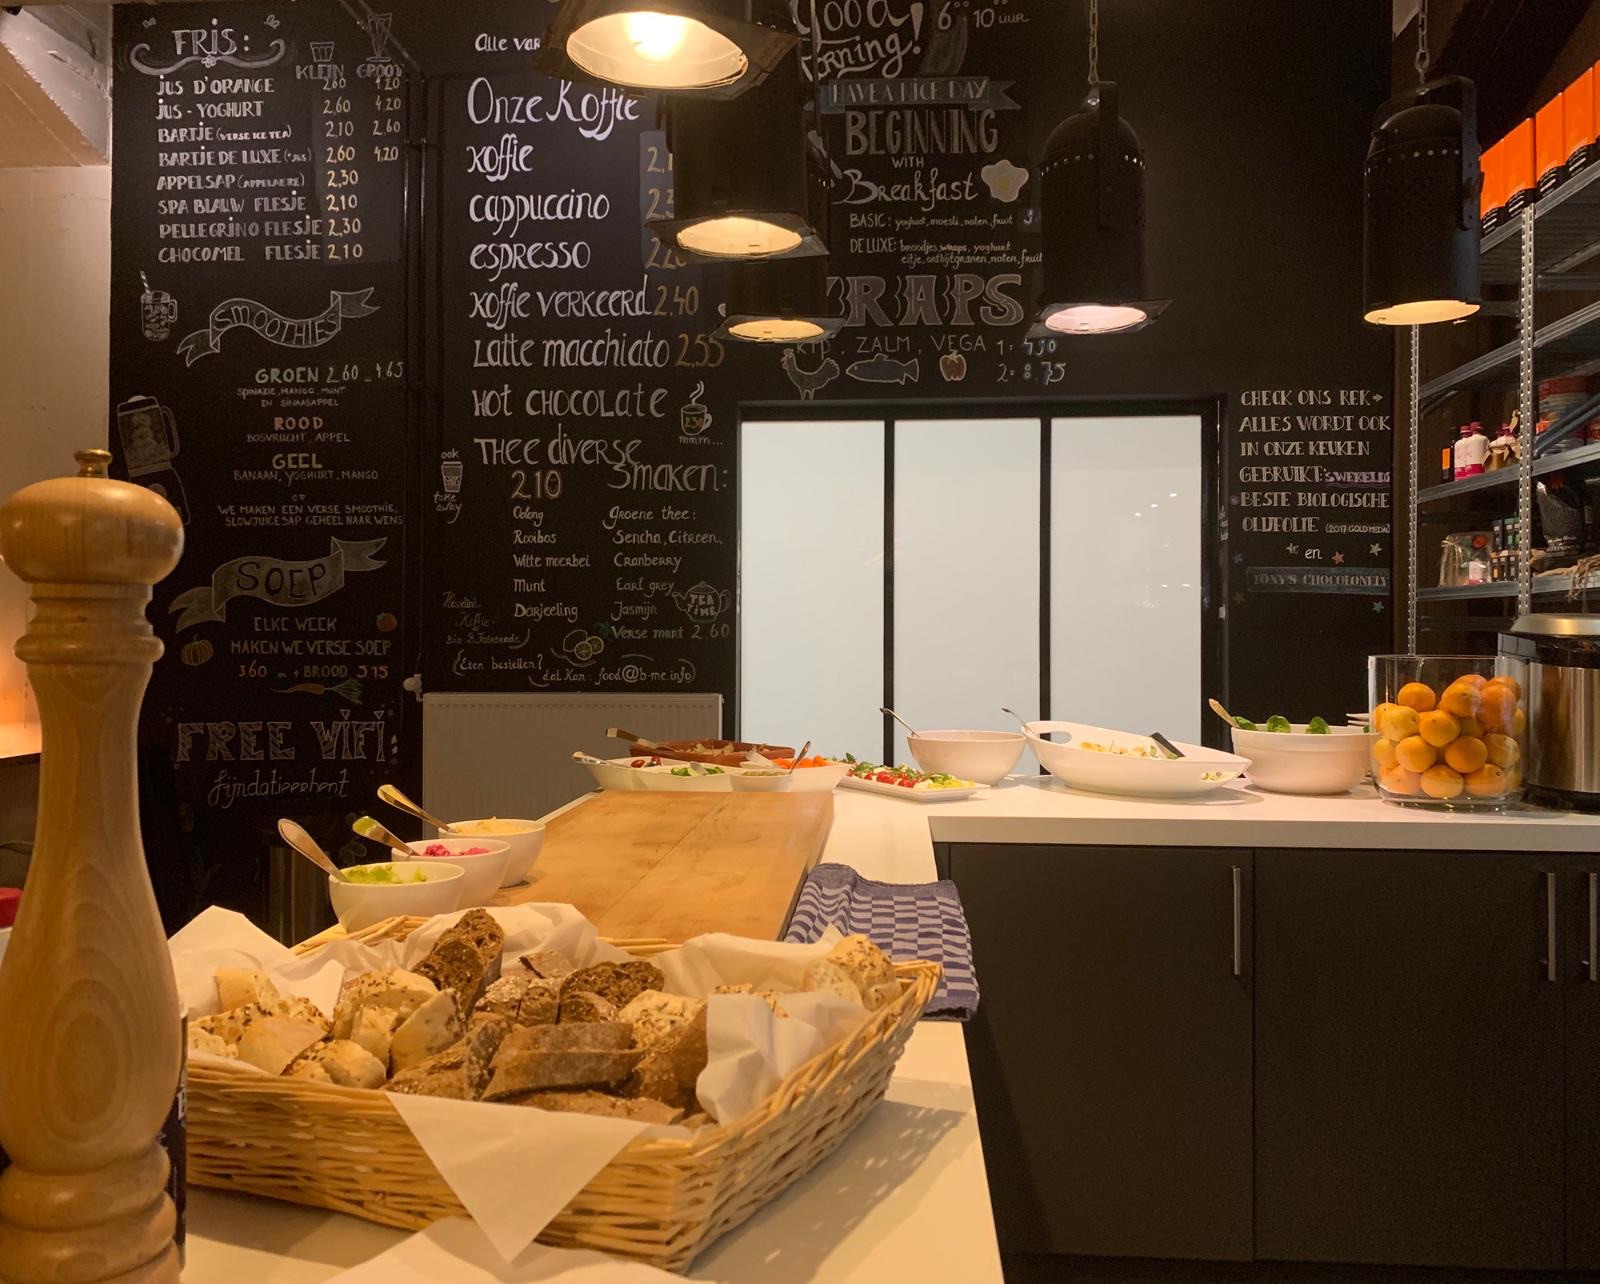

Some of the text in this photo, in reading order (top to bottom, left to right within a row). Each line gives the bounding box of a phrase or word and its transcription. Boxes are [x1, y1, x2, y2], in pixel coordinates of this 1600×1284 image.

[295, 64, 345, 80] KLEIN
[193, 76, 275, 95] D'ORANGE
[948, 79, 988, 99] DAY
[467, 77, 641, 141] Onze Koffie
[158, 121, 214, 143] BARTJE
[845, 108, 999, 156] BEGINNING
[158, 146, 281, 167] BARTJE DE LUXE
[891, 156, 925, 169] WITH
[157, 175, 235, 191] APPELSAP
[831, 168, 980, 212] Breakfast
[158, 190, 306, 215] SPA BLAUW FLESJE
[469, 189, 611, 238] cappuccino
[849, 213, 892, 229] BASIC:
[160, 214, 322, 239] PELLEGRINO FLESJE
[158, 239, 320, 263] CHOCOMEL FLESJE
[469, 241, 591, 281] espresso
[212, 304, 339, 346] SMOOTHIES
[472, 328, 671, 369] Latte macchiato
[931, 334, 986, 353] VEGA
[254, 367, 319, 384] GROEN
[1240, 390, 1371, 406] CHECK ONS REK
[273, 416, 324, 431] ROOD
[1239, 415, 1391, 432] ALLES WORDT OOK
[315, 432, 351, 443] APPEL
[1240, 440, 1371, 456] IN ONZE KEUKEN
[272, 453, 322, 470] GEEL
[341, 469, 379, 481] MANGO
[1240, 490, 1391, 508] BESTE BIOLOGISCHE
[217, 504, 237, 515] WE
[240, 504, 276, 515] MAKEN
[281, 504, 303, 515] EEN
[307, 504, 341, 514] VERSE
[305, 514, 344, 527] GEHEEL
[345, 514, 372, 526] NAAR
[1348, 524, 1369, 533] GOLD
[513, 530, 558, 545] Rooibos
[613, 551, 682, 573] Cranberry
[1304, 547, 1323, 560] en
[236, 562, 327, 599] SOEP
[514, 602, 579, 623] Darjeeling
[254, 616, 337, 632] ELKE WEEK
[609, 624, 648, 640] Verse
[231, 640, 392, 656] MAKEN WE VERSE SOEP
[303, 665, 348, 678] BROOD
[176, 719, 296, 762] FREE
